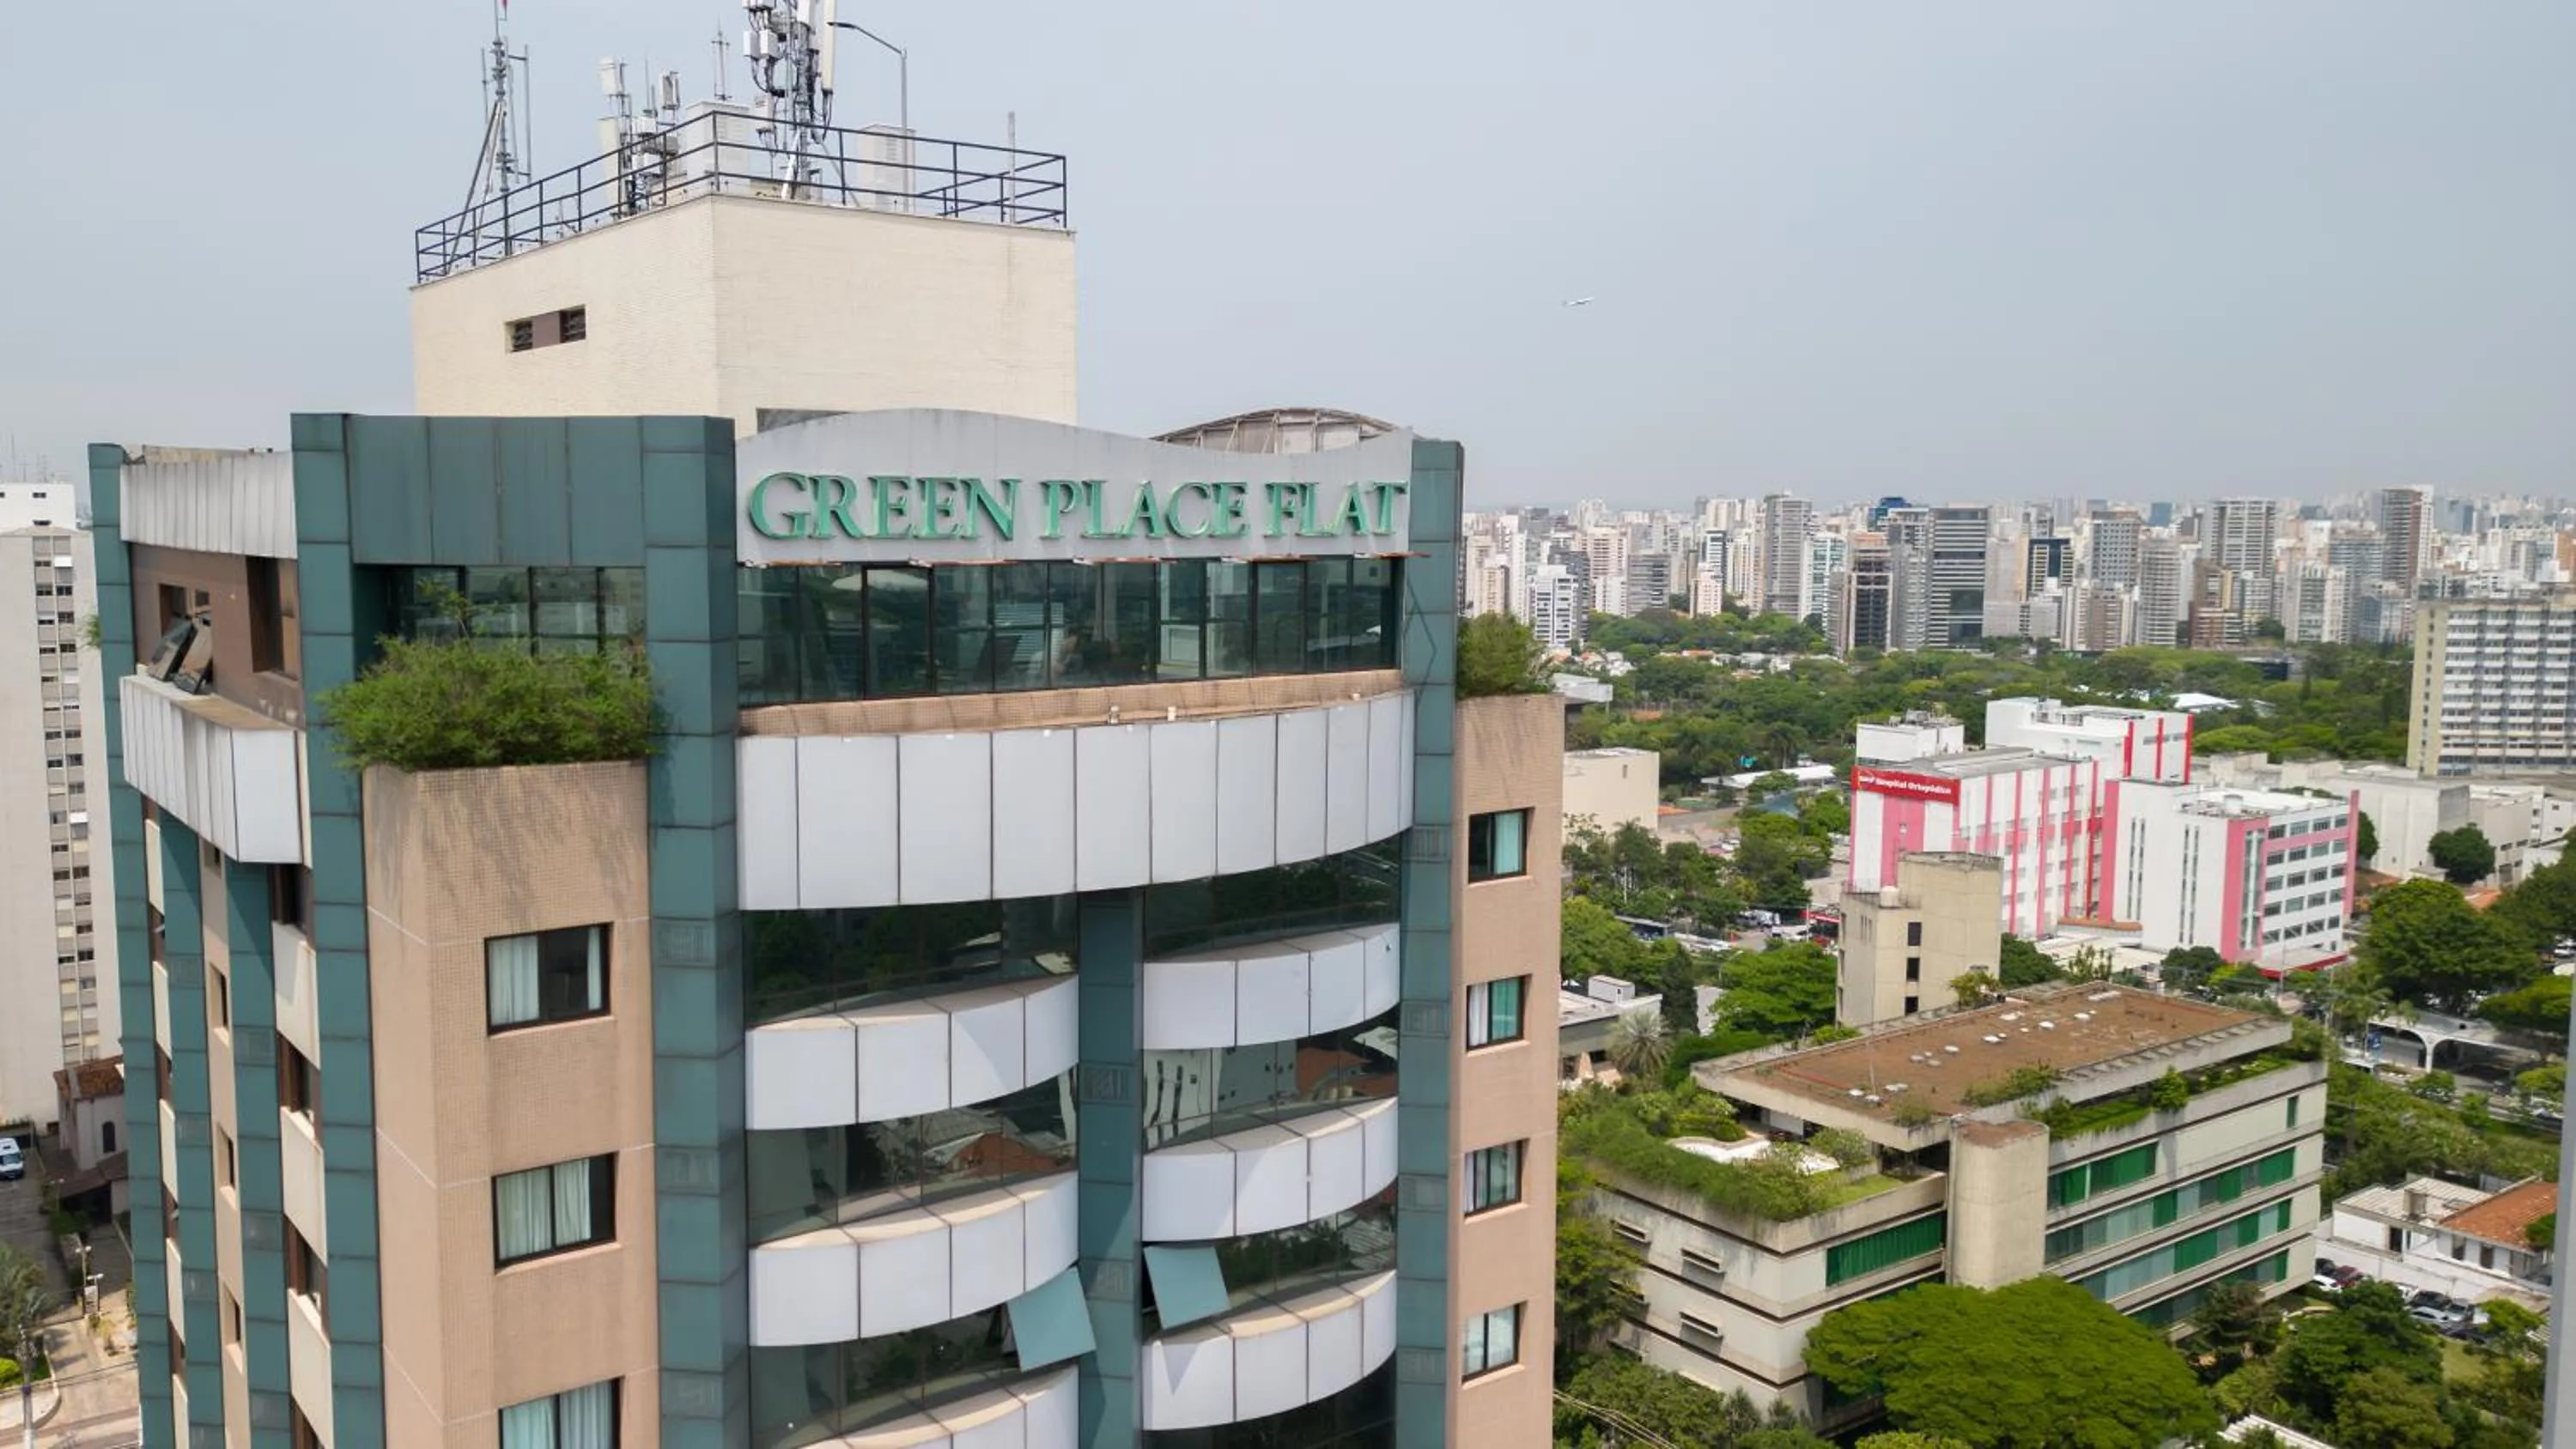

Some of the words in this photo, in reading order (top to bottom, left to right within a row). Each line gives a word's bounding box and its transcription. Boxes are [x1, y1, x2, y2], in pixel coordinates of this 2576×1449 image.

[749, 471, 1022, 541] GREEN
[1039, 480, 1249, 539] PLACE
[1263, 481, 1409, 539] FLAT
